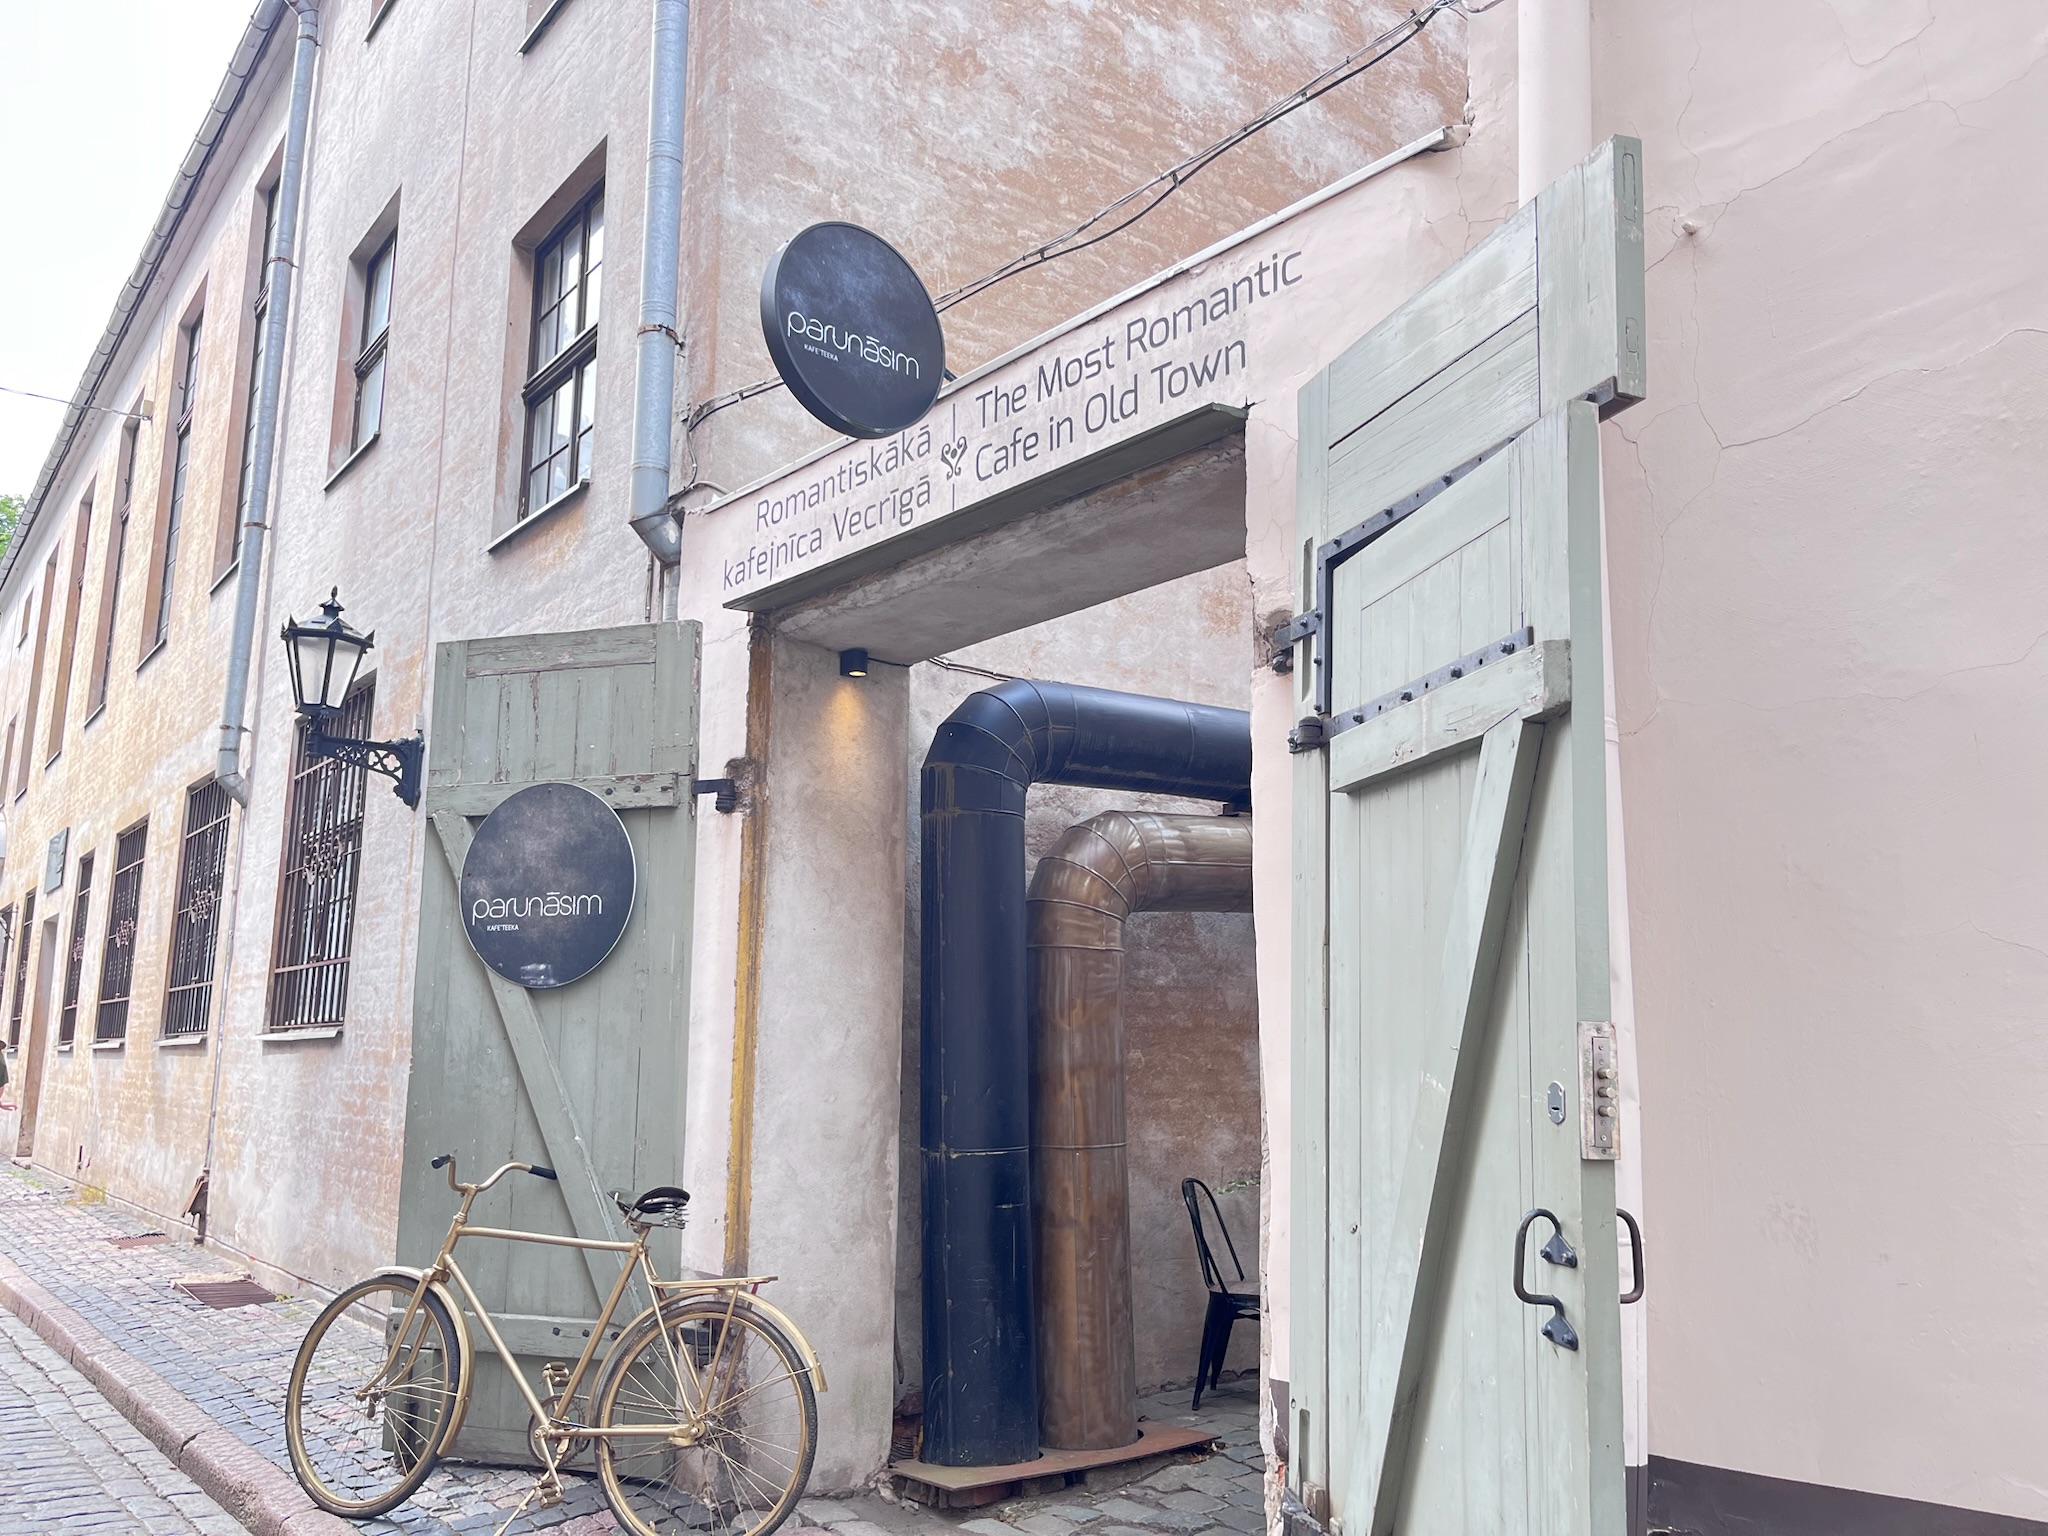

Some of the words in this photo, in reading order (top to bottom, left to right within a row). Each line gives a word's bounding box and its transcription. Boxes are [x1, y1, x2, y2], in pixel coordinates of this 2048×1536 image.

[787, 311, 920, 380] parunāsim
[976, 384, 1027, 428] The
[1037, 336, 1115, 403] Most
[1126, 251, 1303, 361] Romantic
[975, 427, 1039, 482] Cafe
[1049, 416, 1074, 452] in
[1085, 374, 1138, 434] Old
[1151, 340, 1246, 404] Town
[723, 527, 822, 591] kafejnīca
[833, 475, 931, 542] Vecrīgā
[756, 424, 931, 533] Romantiskākā
[472, 891, 602, 926] parunāsim
